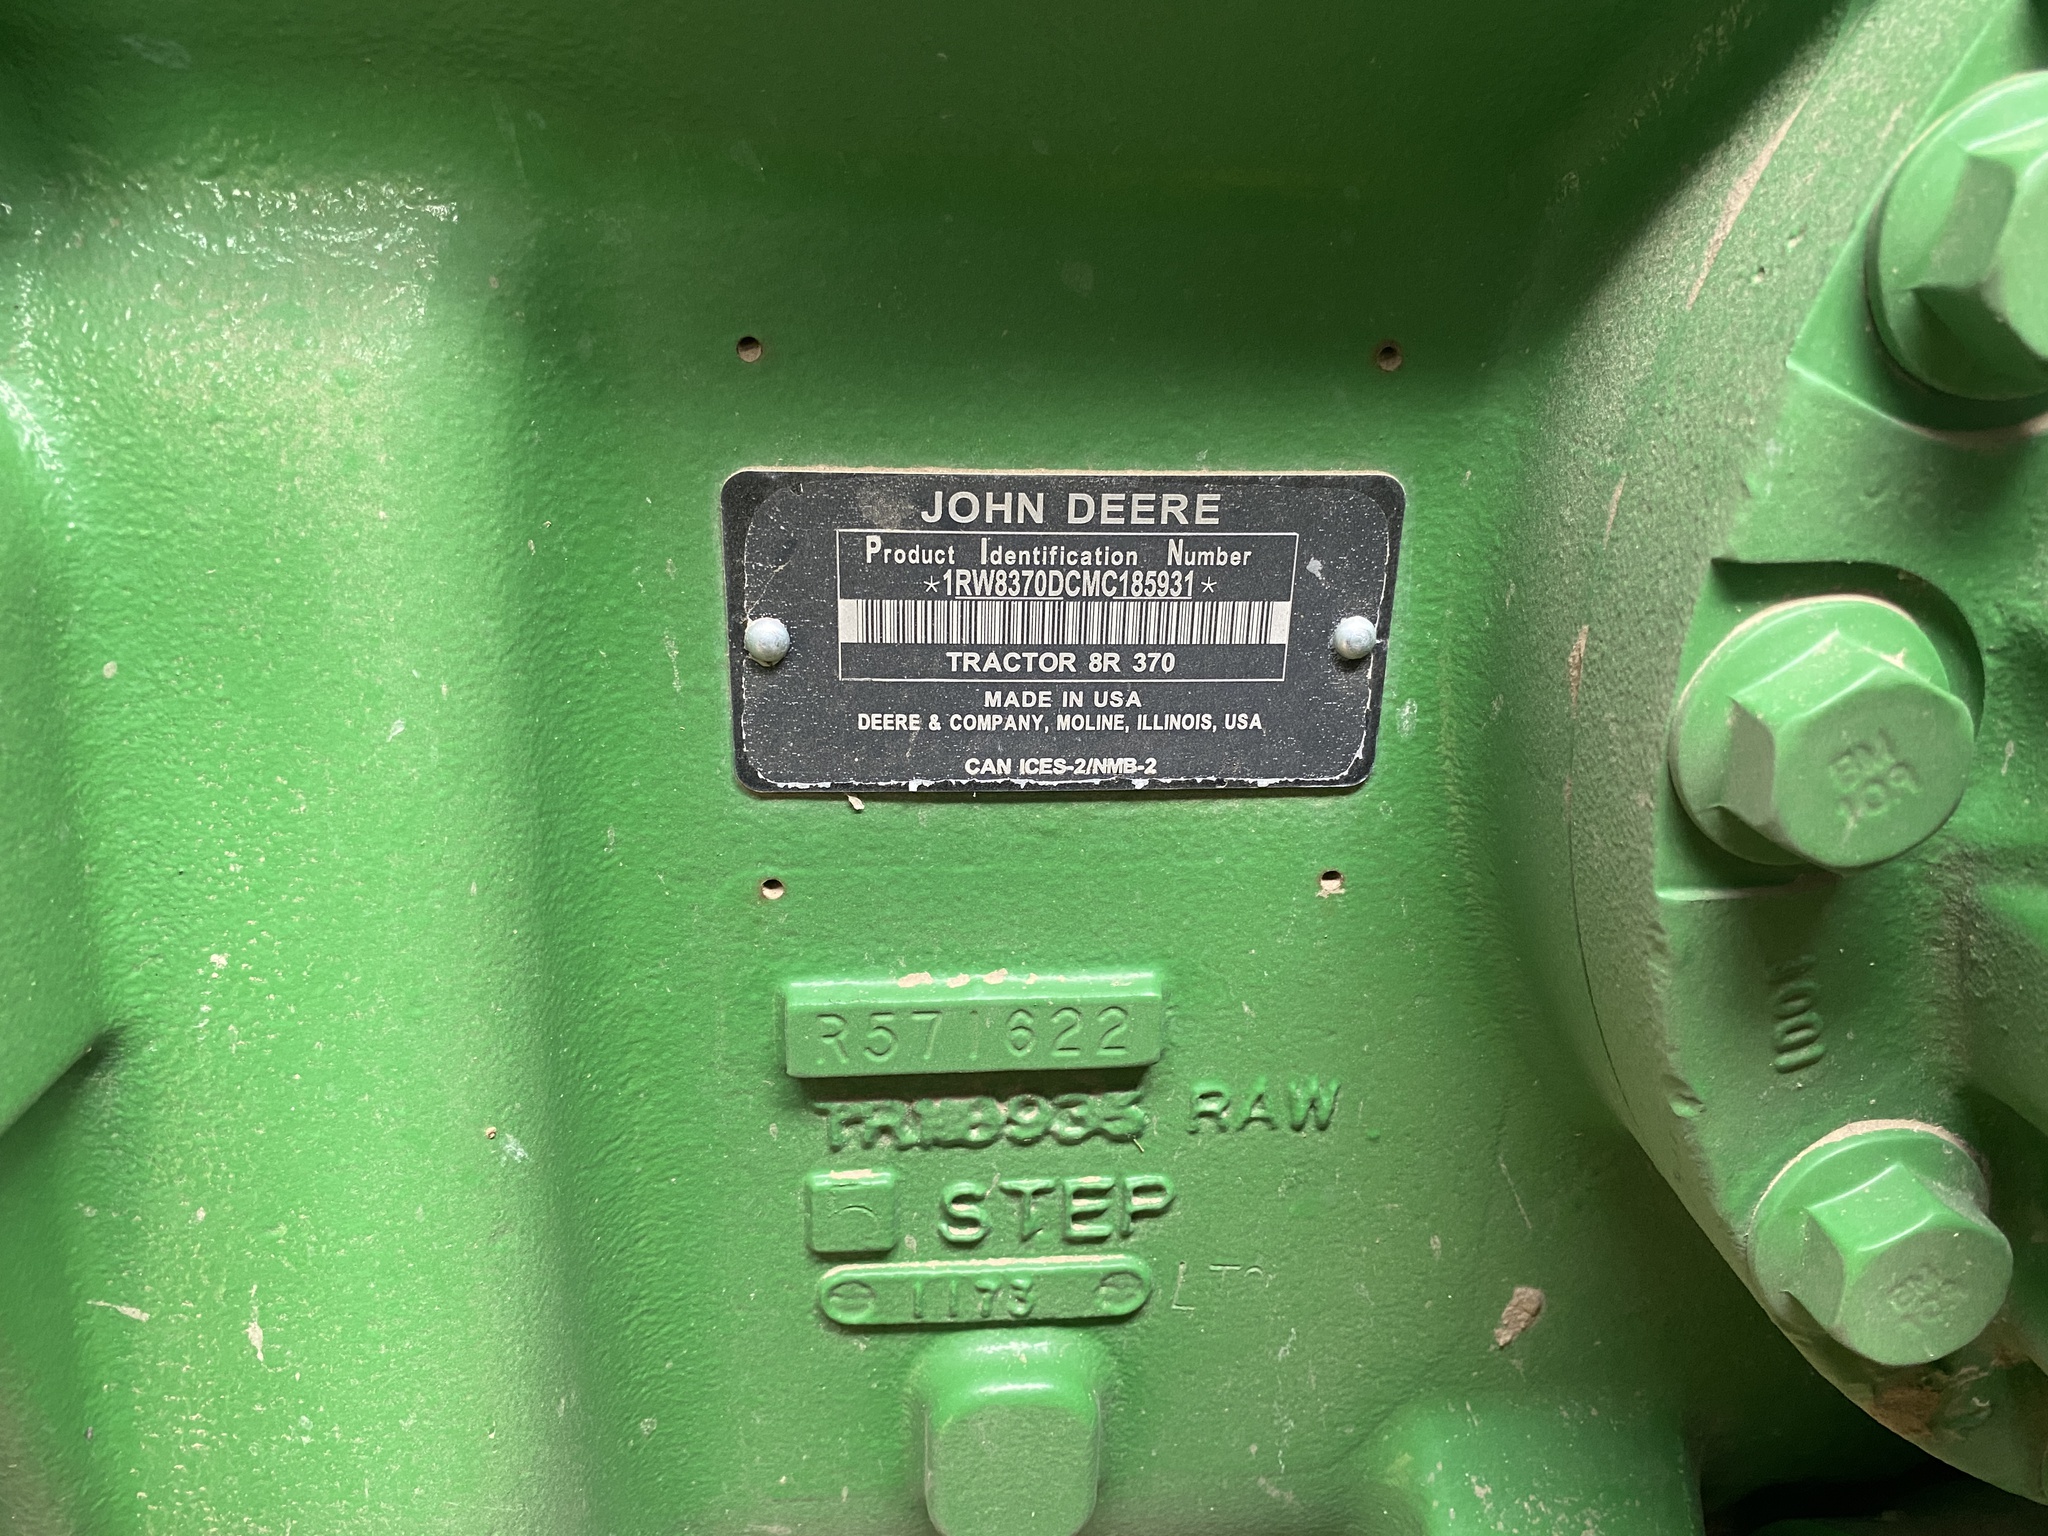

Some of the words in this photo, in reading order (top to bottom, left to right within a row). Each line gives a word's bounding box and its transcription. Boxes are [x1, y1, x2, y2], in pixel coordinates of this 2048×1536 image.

[921, 491, 1044, 524] JOHN
[1067, 492, 1221, 525] DEERE
[866, 535, 955, 564] Product
[980, 537, 1138, 566] Identification
[1166, 538, 1252, 566] Number
[946, 651, 1076, 673] TRACTOR
[1088, 652, 1121, 673] 8R
[1132, 652, 1175, 673] 370
[984, 690, 1052, 708] MADE
[1062, 690, 1083, 708] IN
[1093, 690, 1142, 708] USA
[857, 713, 921, 731] DEERE
[928, 713, 942, 731] &
[950, 714, 1049, 733] COMPANY,
[1056, 713, 1129, 733] MOLINE,
[1137, 713, 1217, 733] ILLINOIS,
[1224, 713, 1263, 730] USA
[964, 758, 1012, 776] CAN
[1019, 757, 1158, 776] ICES-2/NMB-2
[815, 1005, 1129, 1065] R571622
[1186, 1074, 1341, 1136] RAW
[938, 1173, 1177, 1244] STEP
